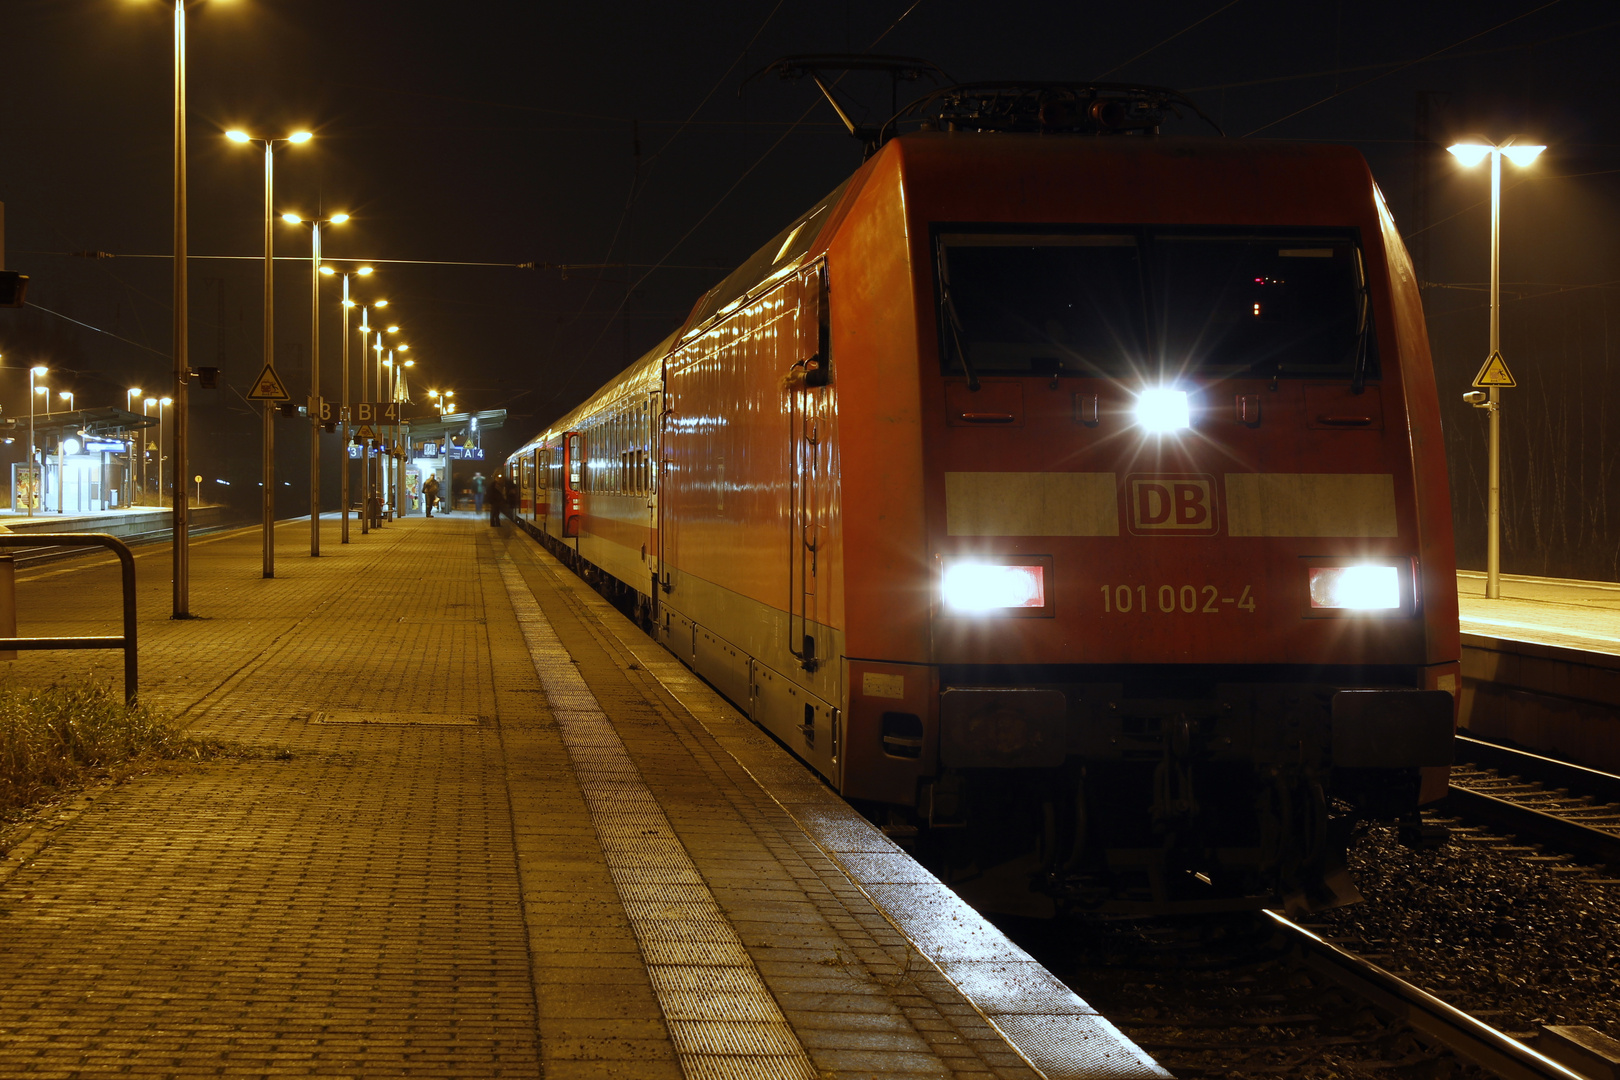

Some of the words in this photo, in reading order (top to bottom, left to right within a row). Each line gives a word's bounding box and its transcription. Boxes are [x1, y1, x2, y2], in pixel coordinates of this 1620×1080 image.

[358, 403, 372, 421] B
[384, 403, 396, 421] 4
[350, 447, 357, 457] 3
[464, 449, 472, 458] A
[477, 449, 484, 458] 4
[1138, 483, 1208, 525] DB
[1101, 584, 1147, 613] 101
[1158, 584, 1256, 613] 002-4
